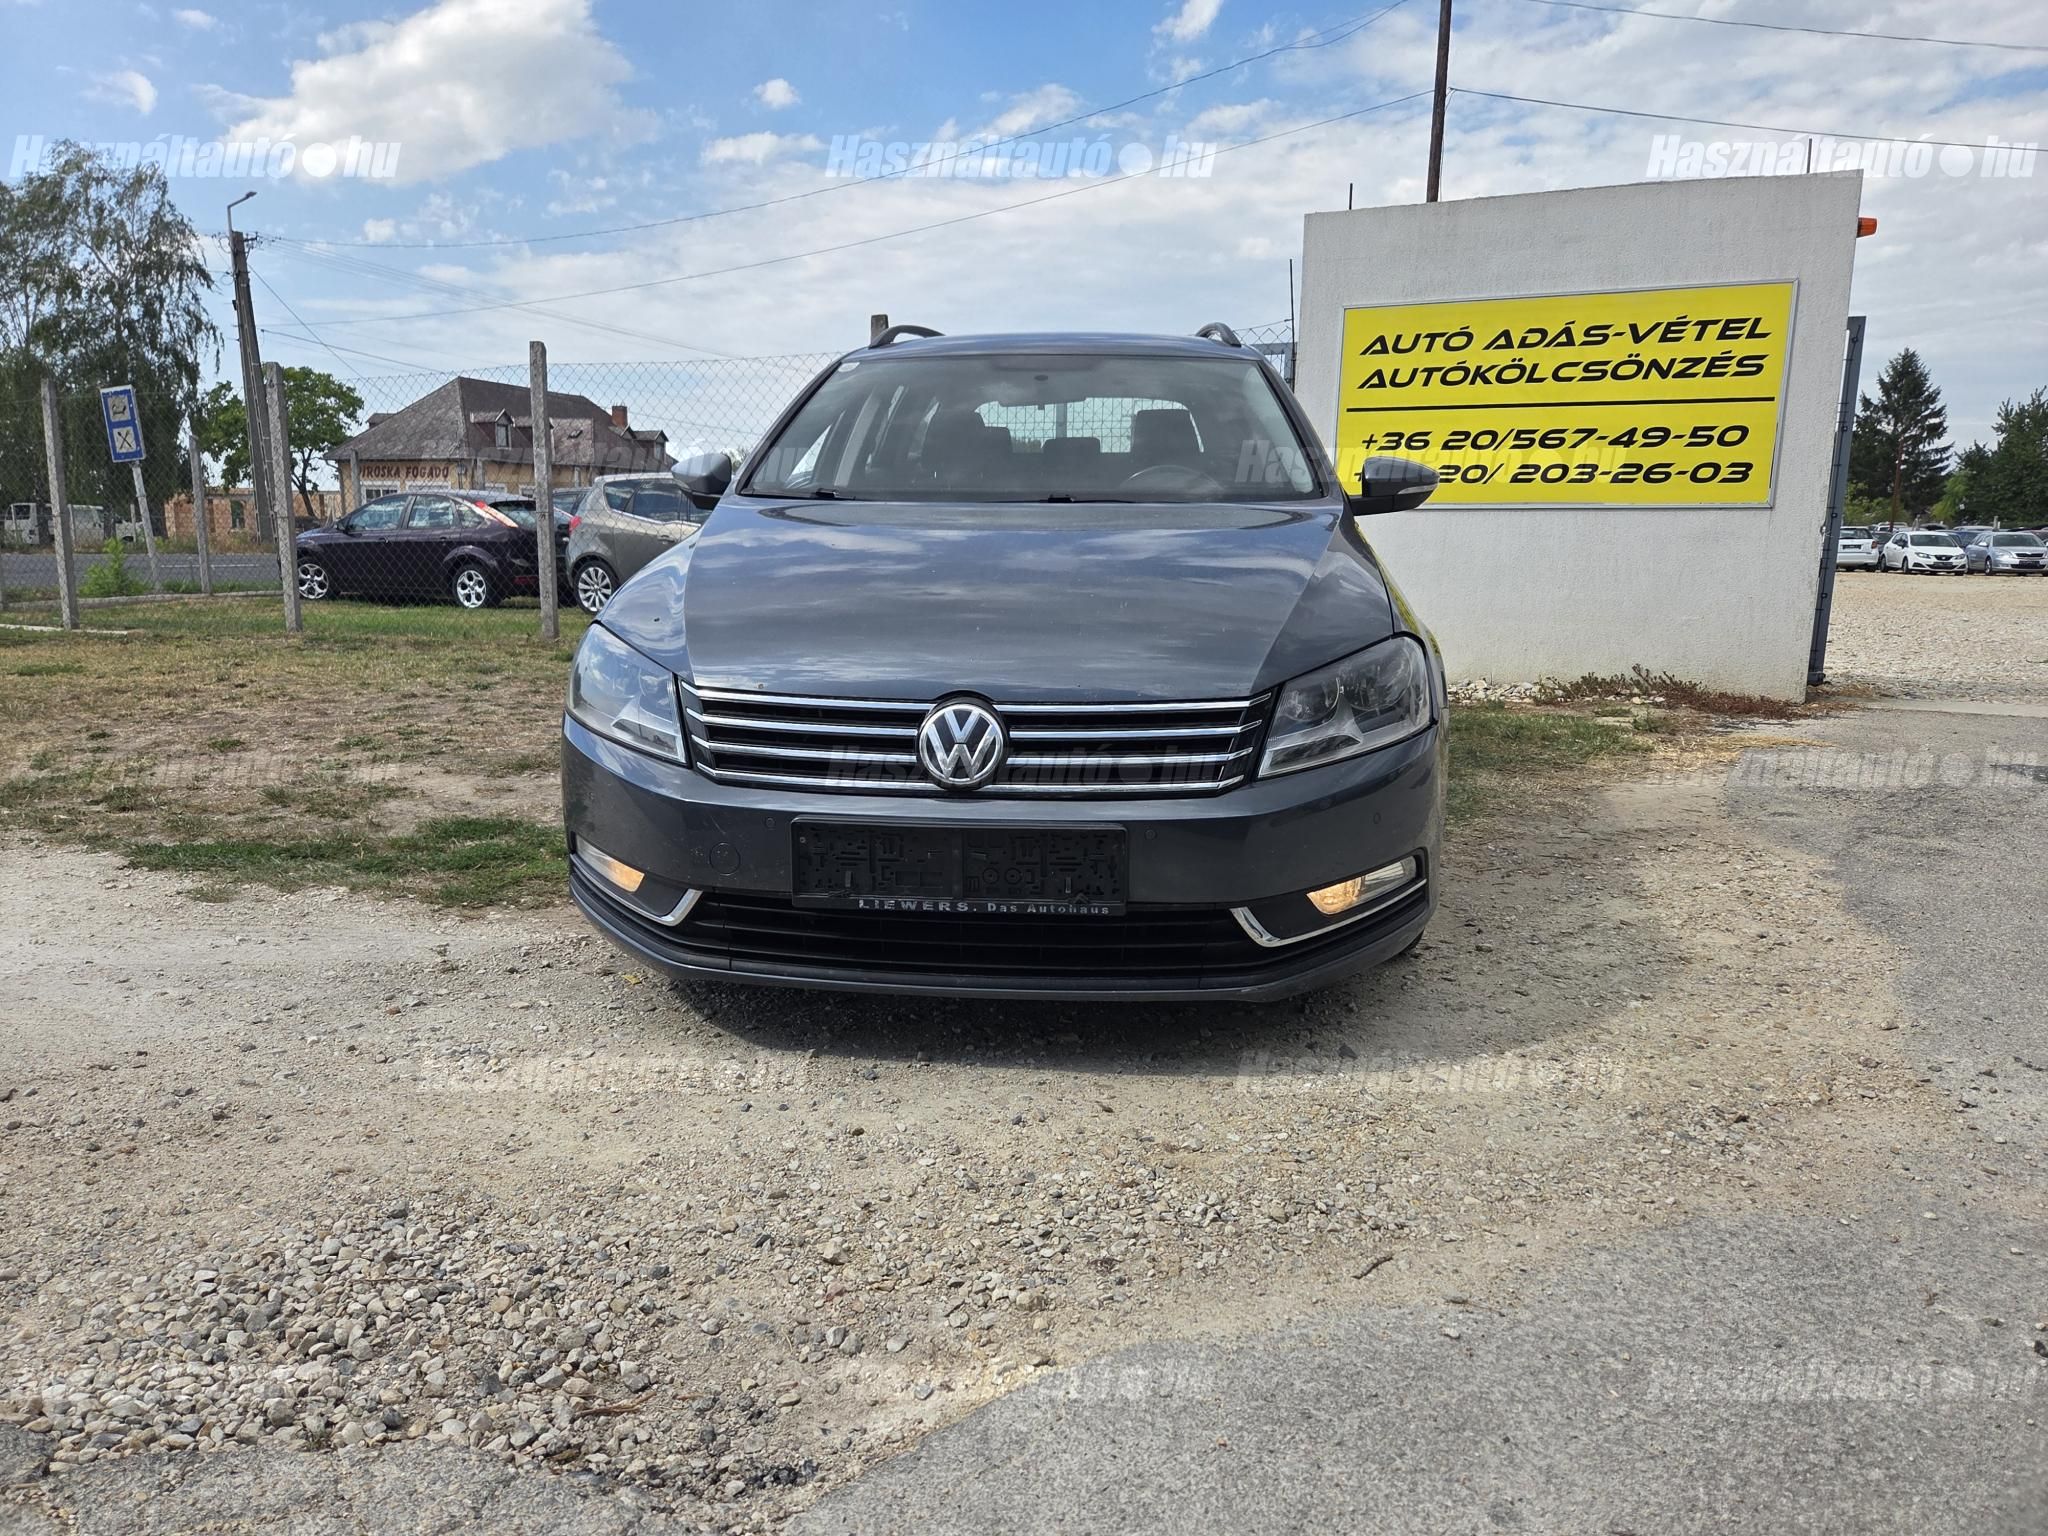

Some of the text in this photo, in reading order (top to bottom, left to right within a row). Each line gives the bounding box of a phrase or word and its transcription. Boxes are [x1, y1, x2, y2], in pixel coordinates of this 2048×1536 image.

[1359, 315, 1772, 356] AUTÓ ADÁS-VÉTEL
[1357, 350, 1770, 390] AUTÓKÖLCSÖNZÉS
[1361, 424, 1750, 451] +36 20/567-49-50
[359, 465, 400, 478] IROSKA
[1509, 461, 1754, 484] 203-26-03
[987, 903, 1017, 913] Das
[1027, 904, 1109, 915] Autohaus
